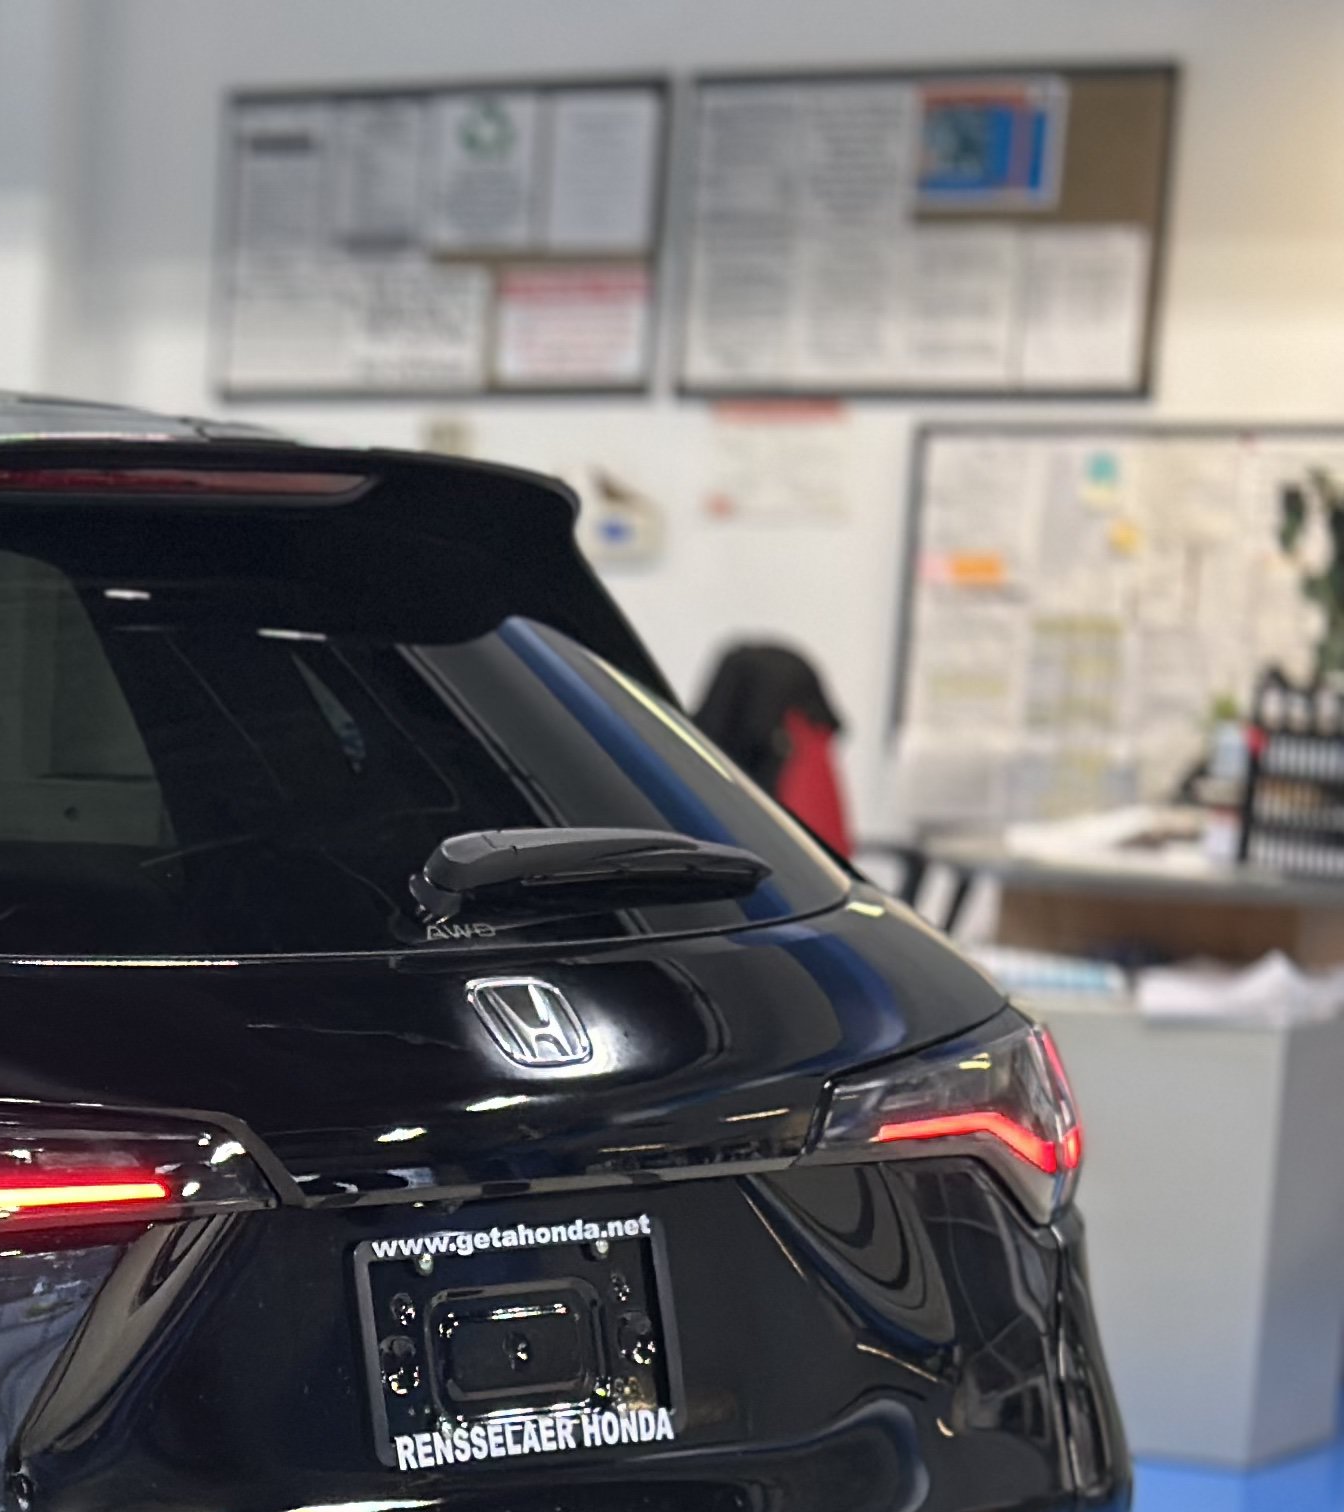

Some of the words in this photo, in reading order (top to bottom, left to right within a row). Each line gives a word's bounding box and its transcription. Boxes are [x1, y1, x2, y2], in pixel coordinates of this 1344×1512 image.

[372, 1213, 651, 1259] www.getahonda.net
[394, 1416, 577, 1471] RENSSELAER
[582, 1407, 675, 1447] HONDA
